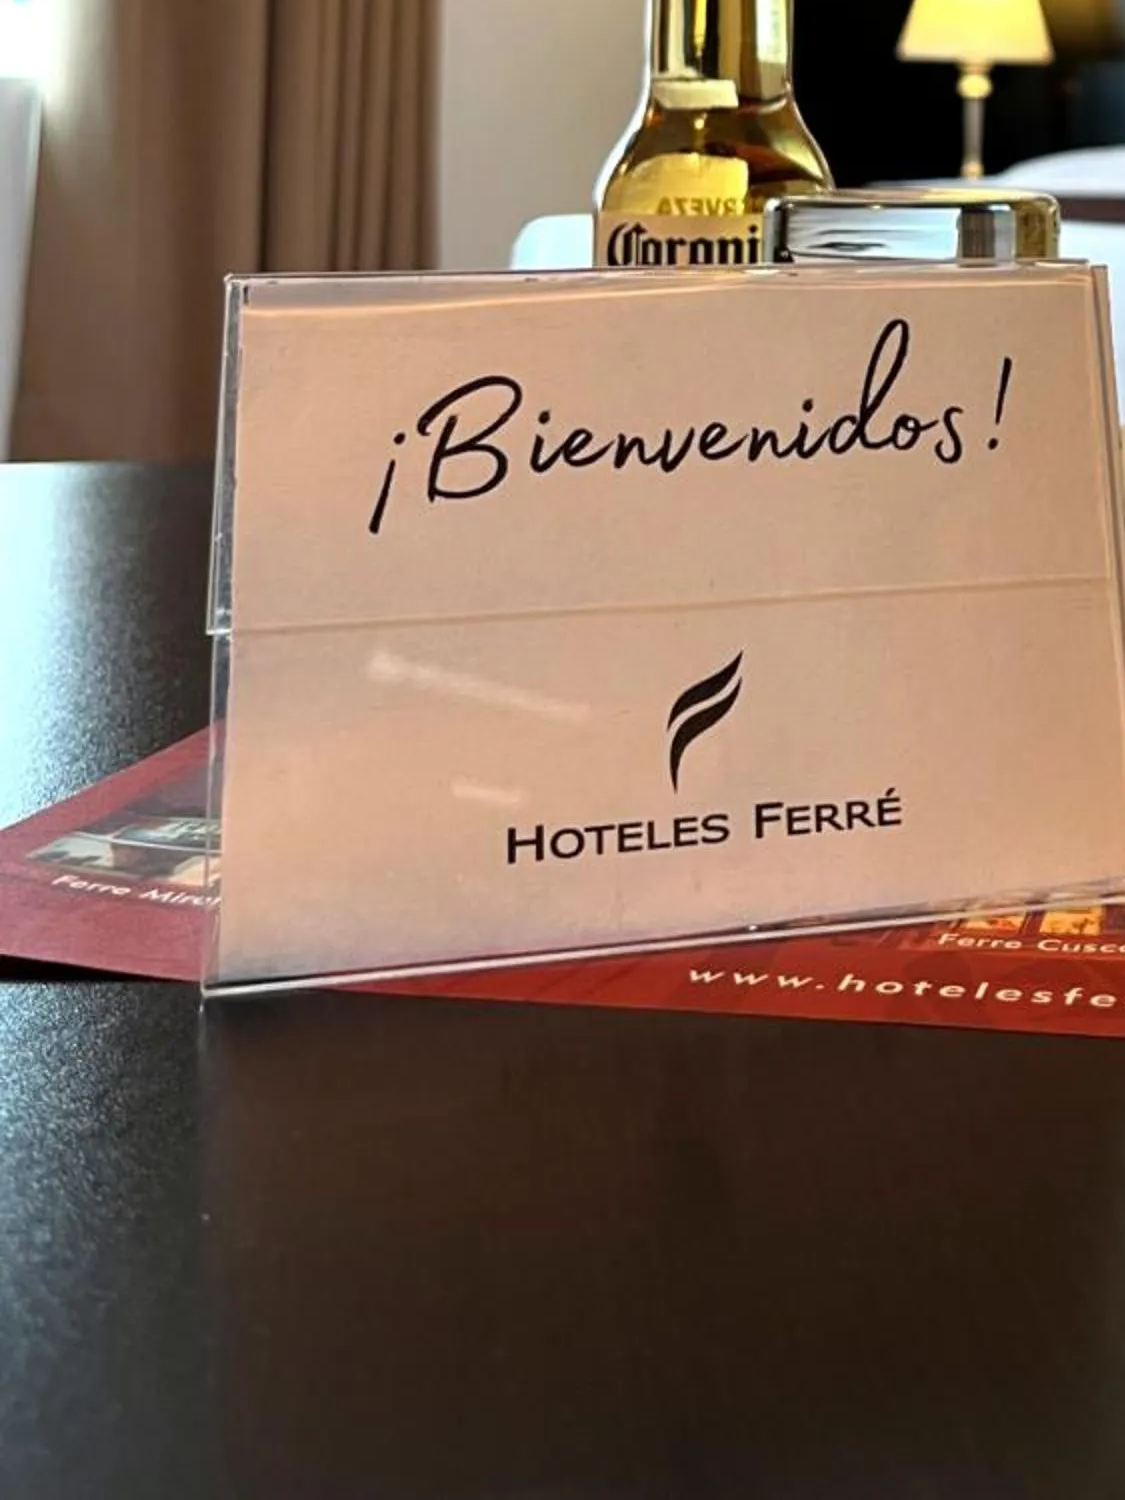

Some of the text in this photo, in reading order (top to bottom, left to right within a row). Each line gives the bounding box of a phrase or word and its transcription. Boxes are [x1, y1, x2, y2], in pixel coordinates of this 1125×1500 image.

[607, 221, 760, 267] Coroni
[368, 318, 1013, 534] ¡Bienvenidos!
[506, 788, 903, 864] HOTELES FERRÉ
[52, 874, 132, 896] Ferre
[937, 933, 1022, 949] Ferre
